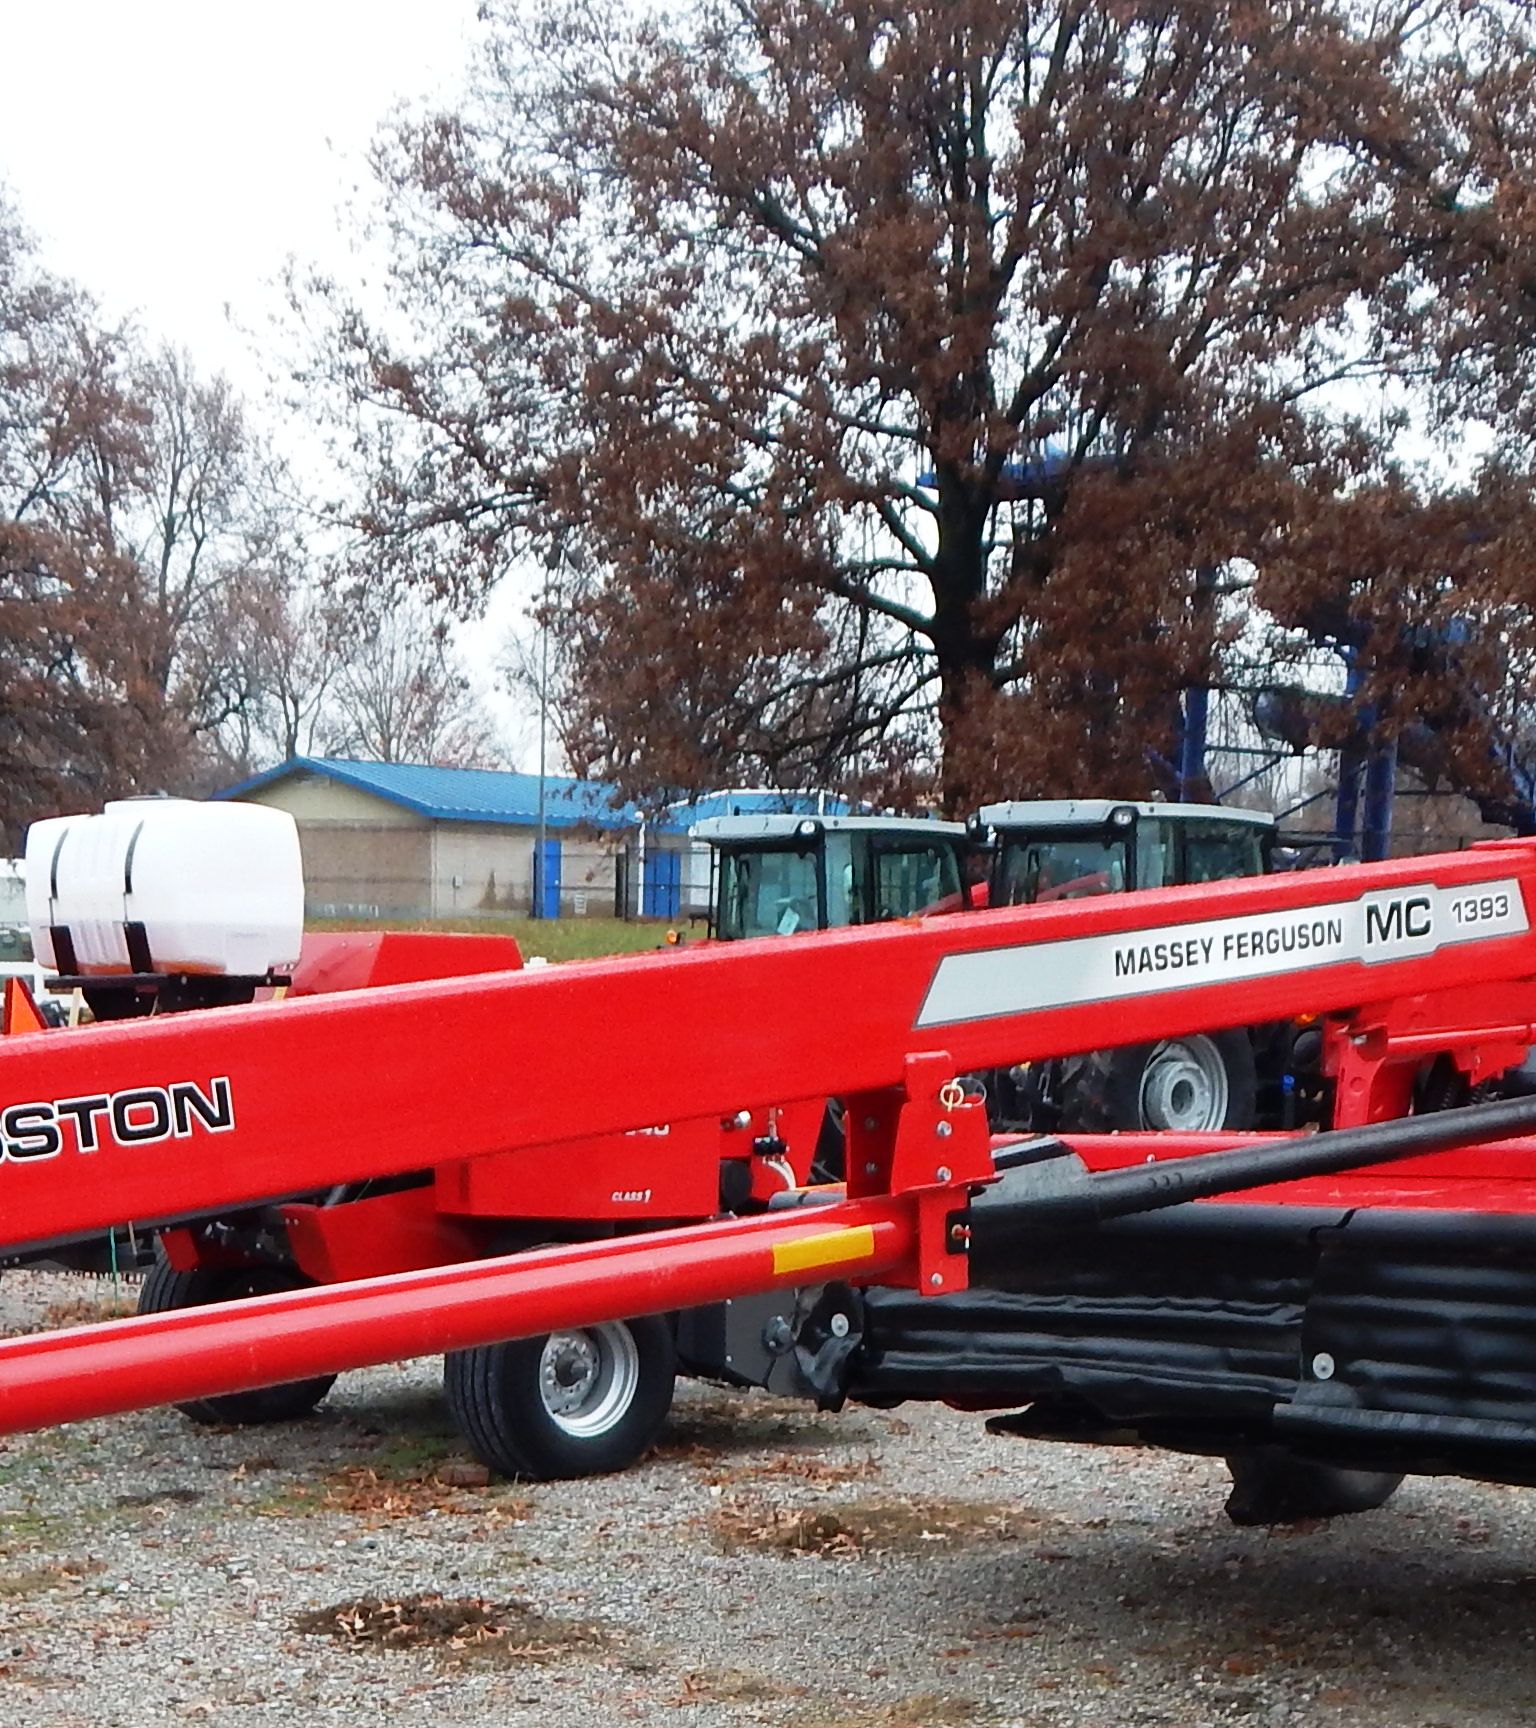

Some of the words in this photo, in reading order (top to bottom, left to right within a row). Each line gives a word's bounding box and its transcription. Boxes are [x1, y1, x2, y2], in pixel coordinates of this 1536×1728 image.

[1115, 936, 1214, 976] MASSEY
[1223, 917, 1343, 961] FERGUSON
[1366, 896, 1432, 944] MC
[1451, 895, 1510, 924] 1393
